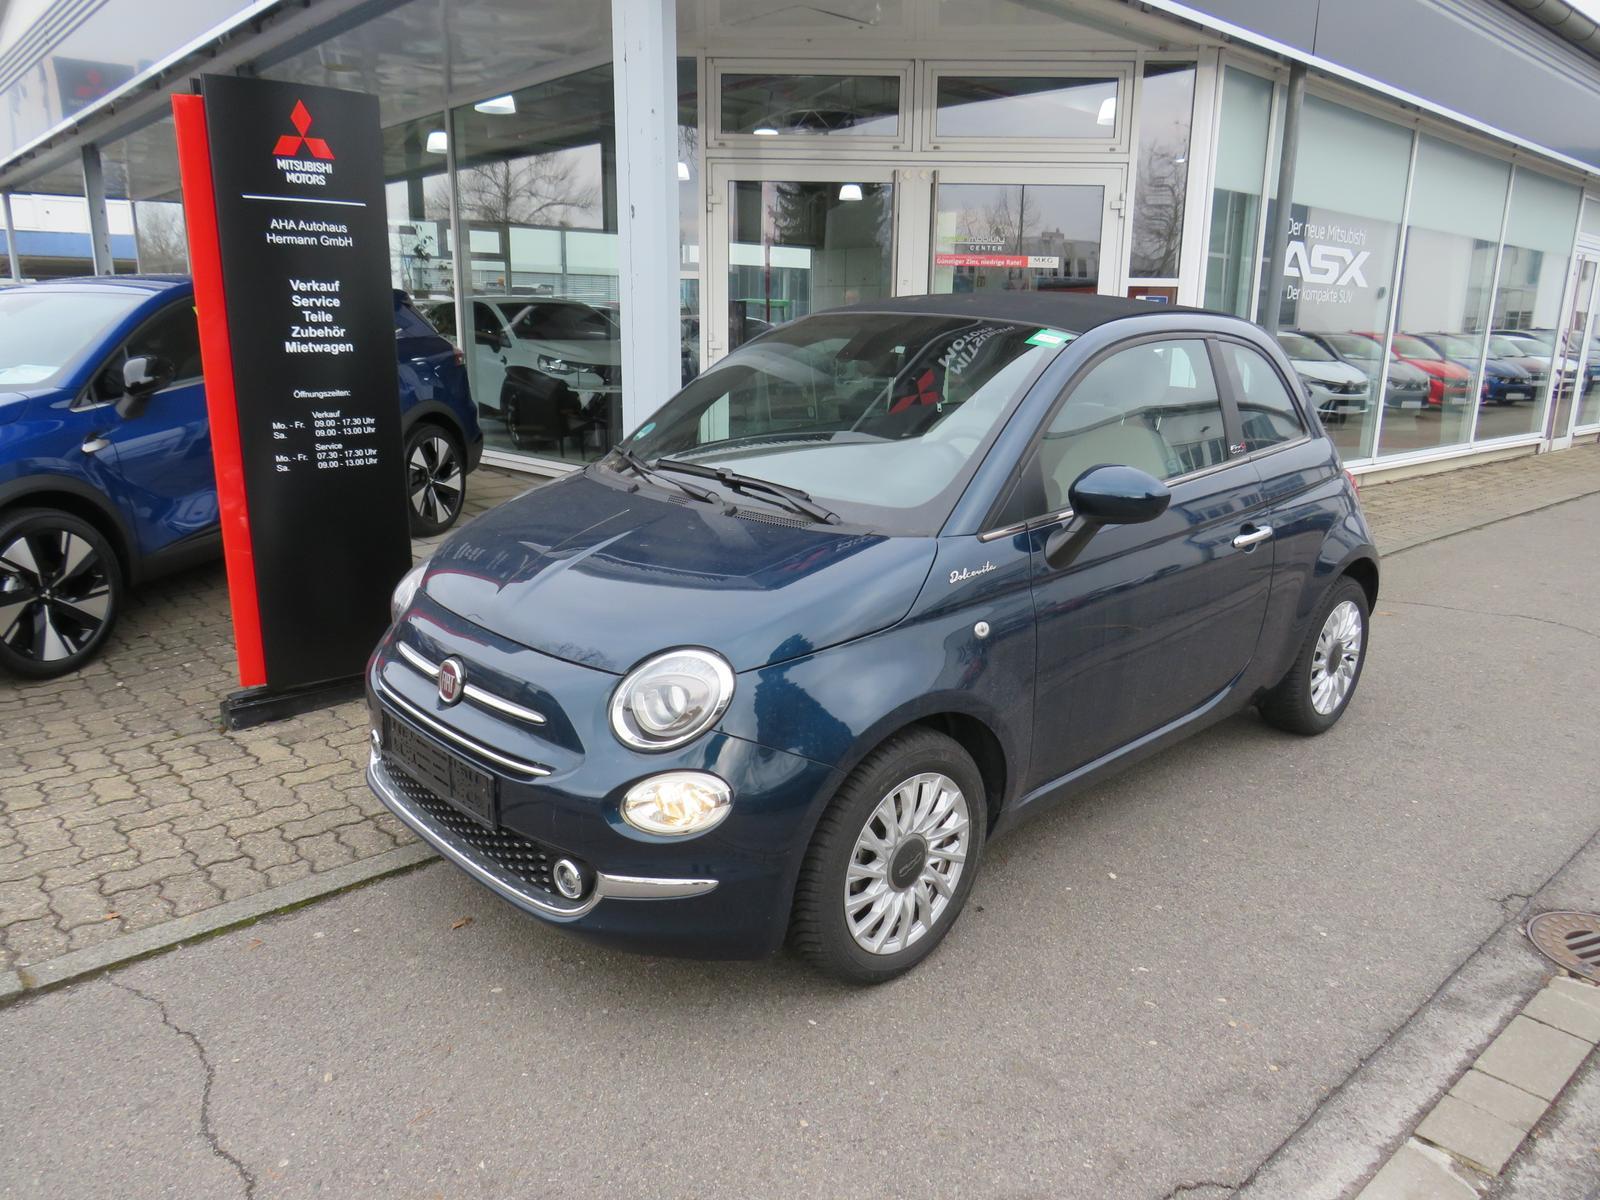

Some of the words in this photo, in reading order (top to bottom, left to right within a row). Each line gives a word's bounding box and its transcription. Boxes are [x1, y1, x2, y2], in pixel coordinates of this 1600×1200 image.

[276, 159, 333, 174] MITSUBISHI
[286, 173, 326, 186] MOTORS
[270, 219, 297, 231] AHA
[298, 220, 348, 233] Autohaus
[1288, 218, 1303, 236] Der
[1304, 223, 1325, 239] neue
[1327, 224, 1367, 245] Mitsubishi
[266, 233, 318, 246] Hermann
[320, 236, 353, 247] GmbH
[969, 244, 1003, 252] CENTER
[1283, 240, 1371, 288] ASX
[289, 279, 341, 292] Verkauf
[291, 295, 341, 307] Service
[1287, 285, 1301, 300] Der
[1302, 287, 1337, 304] kompakte
[1339, 290, 1353, 303] SUV
[302, 311, 333, 323] Teile
[291, 326, 346, 338] Zubehör
[285, 341, 354, 355] Mietwagen
[293, 389, 352, 399] Öffnungszeiten:
[311, 410, 341, 419] Verkauf
[272, 422, 288, 430] Mo.
[294, 421, 306, 429] Fr.
[314, 419, 336, 428] 09.00
[342, 418, 361, 426] 17.30
[362, 417, 376, 425] Uhr
[273, 431, 288, 440] Sa.
[315, 429, 337, 437] 09.00
[343, 427, 362, 435] 13.00
[363, 426, 377, 434] Uhr
[315, 443, 343, 451] Service
[275, 454, 291, 463] Mo.
[297, 453, 309, 461] Fr.
[316, 451, 338, 460] 07.30
[344, 449, 364, 457] 17.30
[364, 448, 378, 456] Uhr
[276, 464, 291, 472] Sa.
[317, 461, 339, 469] 09.00
[345, 459, 364, 467] 13.00
[365, 457, 379, 465] Uhr
[441, 670, 456, 694] FIAT
